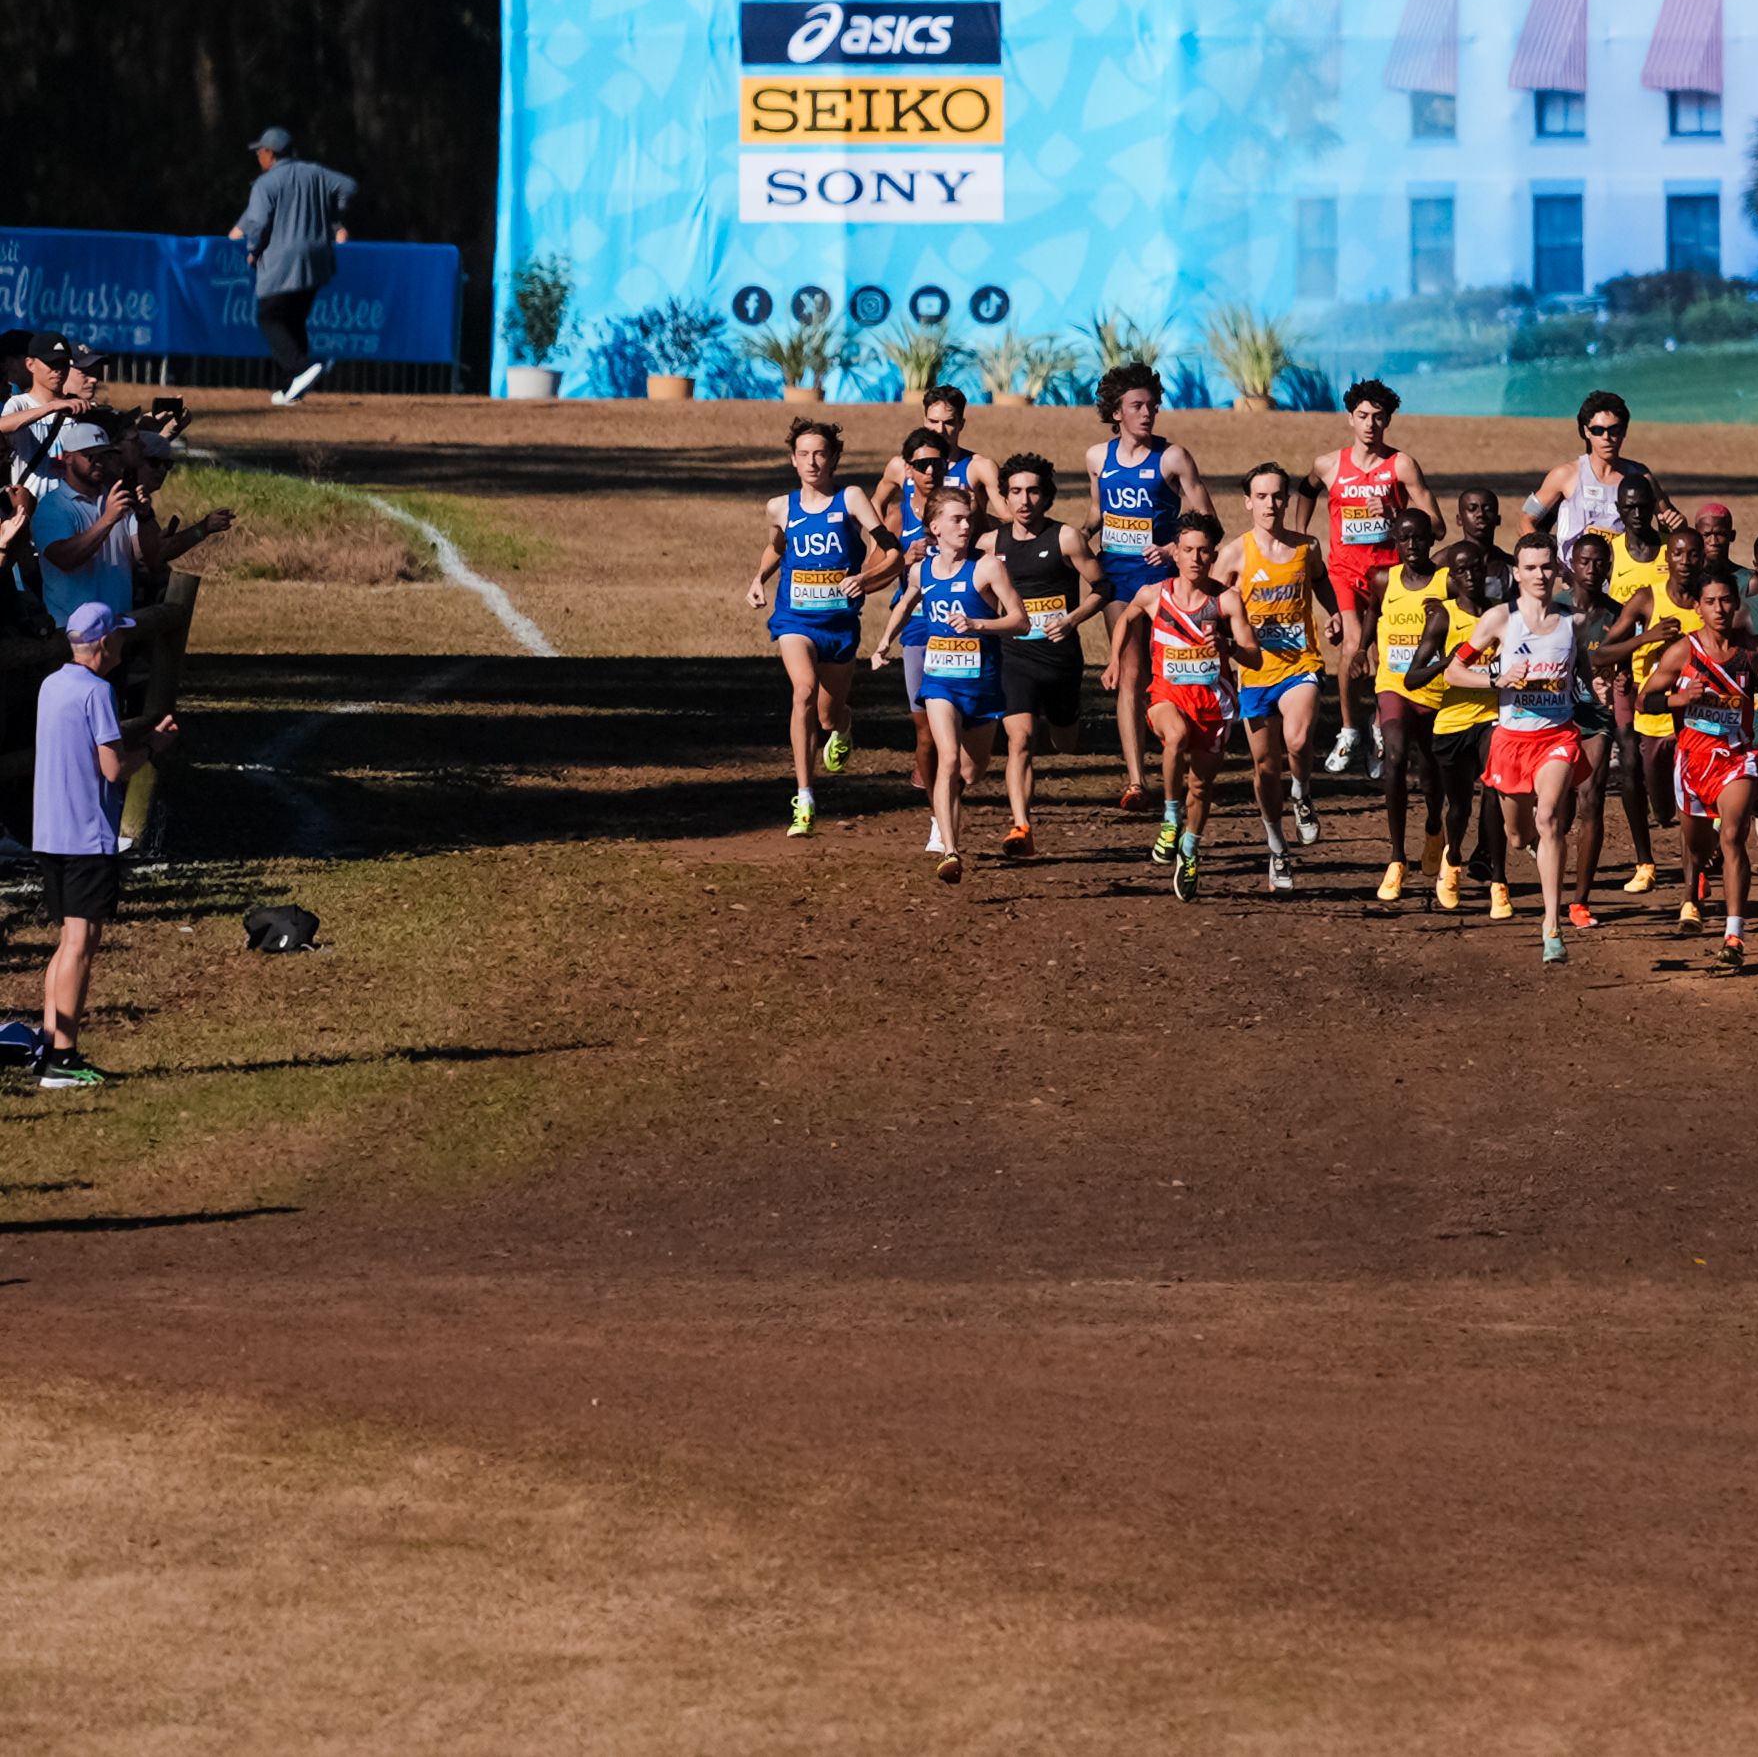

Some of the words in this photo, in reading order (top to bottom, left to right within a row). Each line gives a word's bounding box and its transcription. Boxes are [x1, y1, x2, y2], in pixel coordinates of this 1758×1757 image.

[751, 88, 991, 133] SEIKO
[765, 169, 975, 206] SONY
[1107, 487, 1153, 509] USA
[1340, 484, 1392, 499] JORDAN
[1342, 508, 1372, 520] SEI
[1104, 513, 1150, 531] SEIKO
[1104, 528, 1150, 545] MALONEY
[793, 531, 843, 558] USA
[793, 570, 847, 584] SEIKO
[1023, 598, 1065, 612] EIKO
[1250, 611, 1303, 626] SEIKO
[1388, 612, 1424, 625] UGAN
[1255, 625, 1303, 640] ORSTAD
[928, 638, 978, 652] SEIKO
[930, 653, 976, 667] WIRTH
[1165, 646, 1219, 660] SEIKO
[1166, 660, 1218, 675] SULLCA
[1514, 694, 1567, 707] ABRAHAM
[1687, 707, 1741, 725] MARQUEZ
